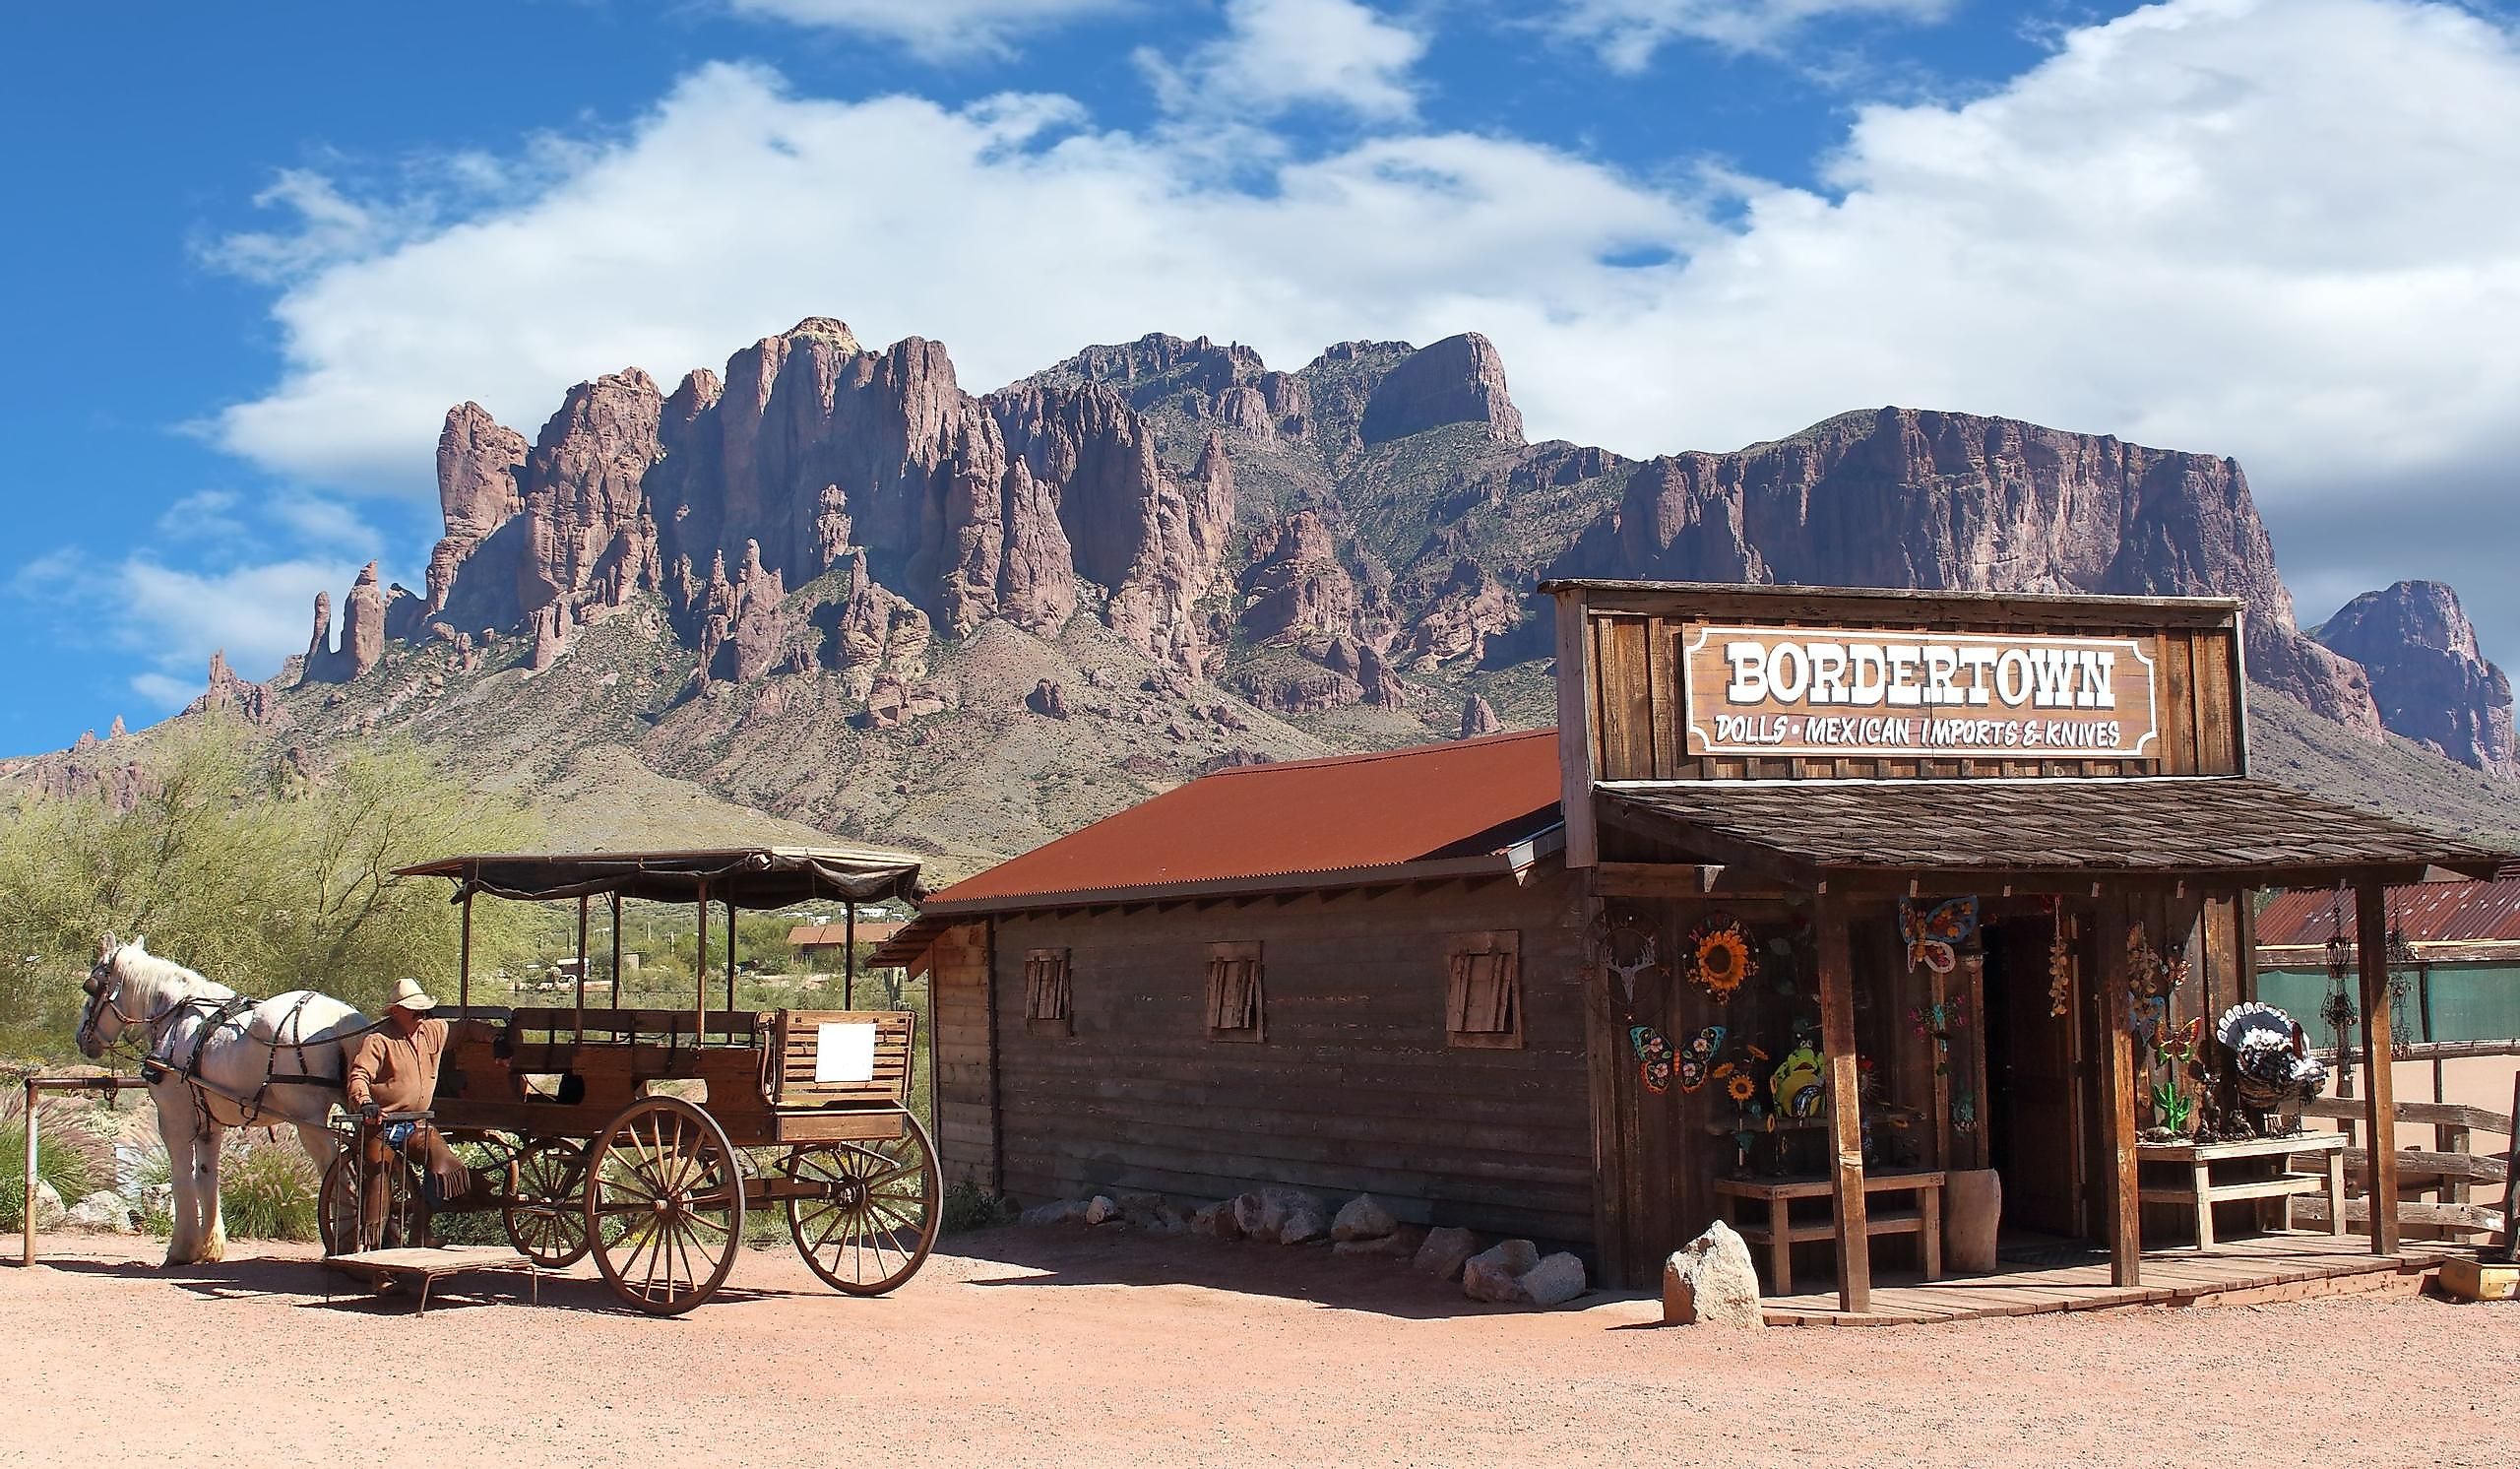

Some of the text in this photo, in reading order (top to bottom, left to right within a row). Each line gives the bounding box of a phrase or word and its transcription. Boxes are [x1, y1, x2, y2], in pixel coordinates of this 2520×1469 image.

[1725, 641, 2115, 711] BORDERTOWN
[1714, 714, 2121, 747] DOLLS MEXICAN IMPORTS & KNIVES
